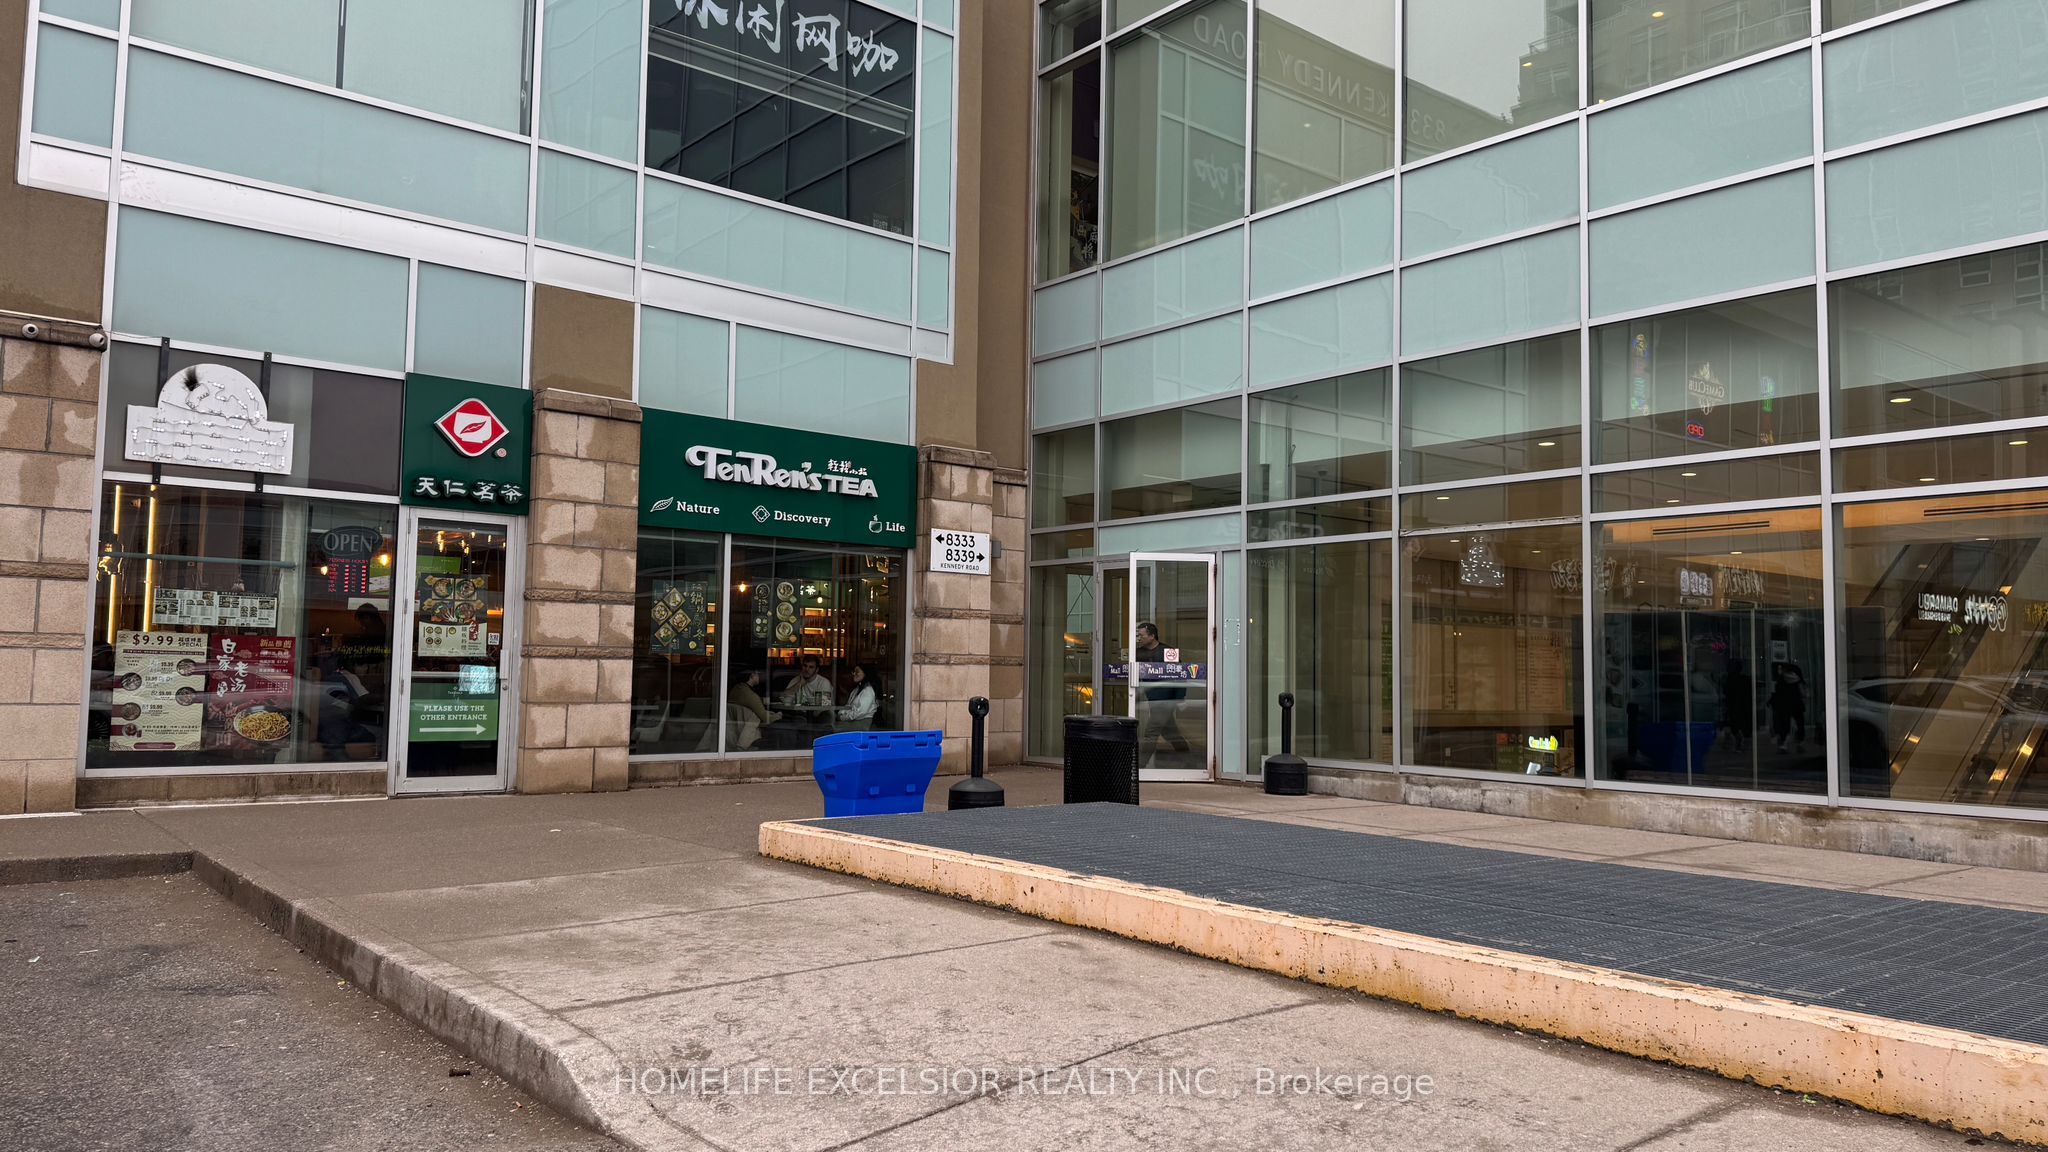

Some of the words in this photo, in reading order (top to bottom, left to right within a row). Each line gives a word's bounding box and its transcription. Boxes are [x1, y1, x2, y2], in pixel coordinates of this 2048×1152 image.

[416, 477, 523, 501] 天仁茗茶
[821, 474, 879, 498] TEA
[676, 501, 720, 515] Nature
[774, 510, 831, 527] Discovery
[886, 522, 906, 533] Life
[324, 532, 373, 553] OPEN
[946, 533, 976, 548] 8333
[945, 548, 975, 563] 8339
[132, 633, 174, 646] $9.99
[1147, 666, 1164, 675] Mall
